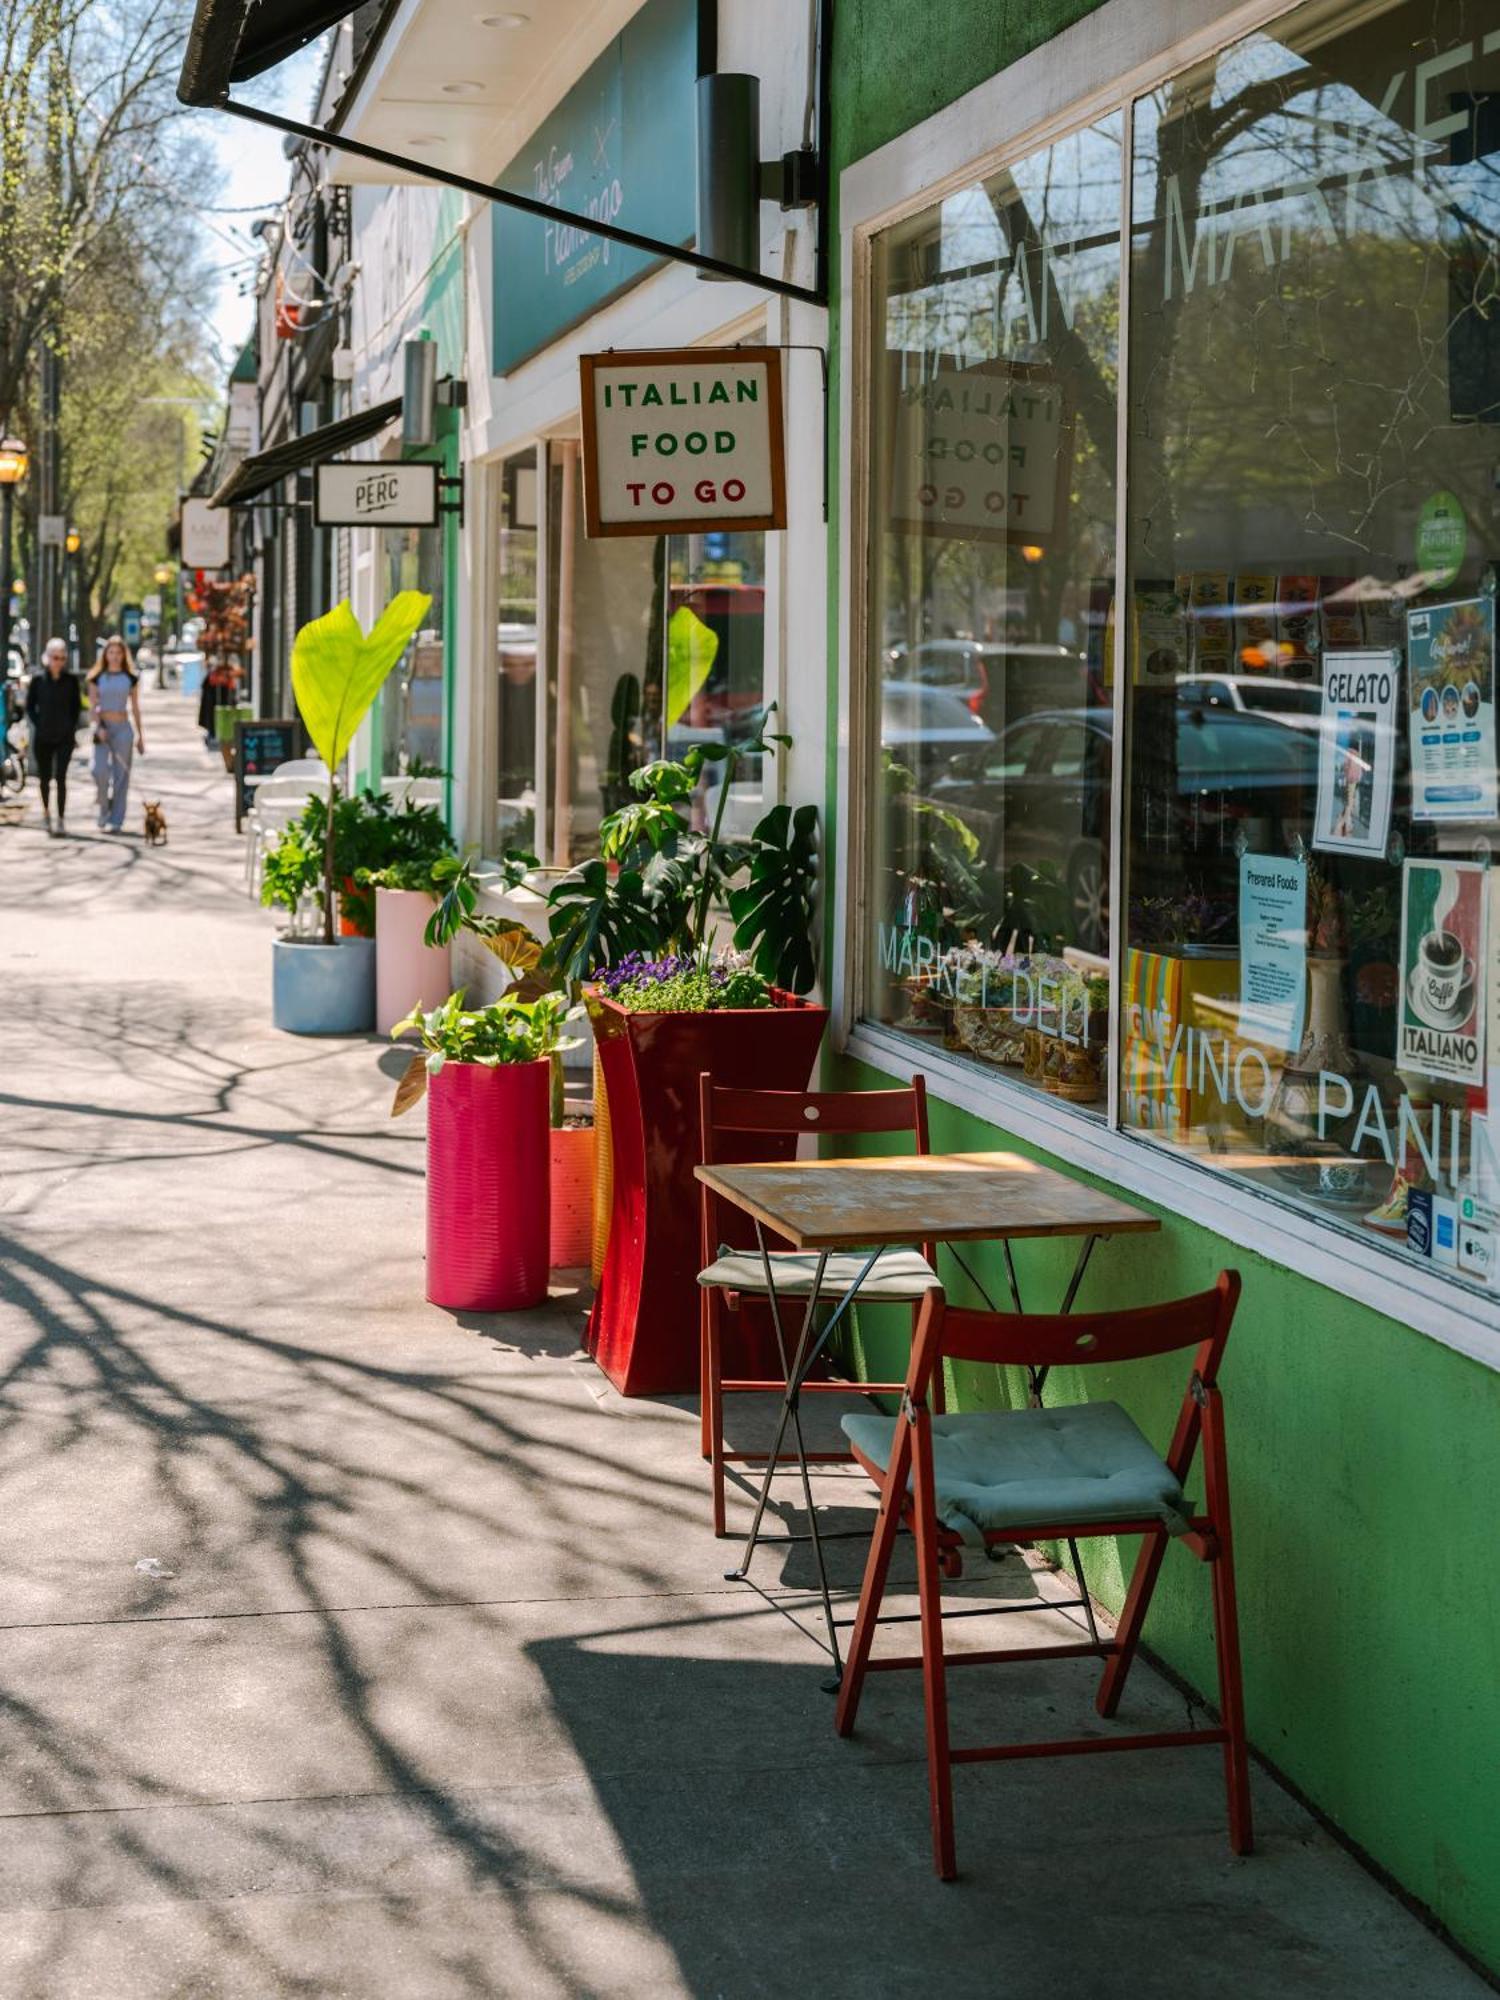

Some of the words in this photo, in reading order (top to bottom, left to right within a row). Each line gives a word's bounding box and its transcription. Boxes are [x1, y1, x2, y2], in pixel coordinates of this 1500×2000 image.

[1164, 31, 1500, 301] MARKE
[604, 379, 758, 408] ITALIAN
[631, 431, 736, 457] FOOD
[356, 478, 398, 508] PERC
[626, 482, 675, 506] TO
[694, 479, 746, 503] GO
[1328, 673, 1390, 704] GELATO
[1277, 874, 1299, 891] Foods
[878, 922, 994, 1009] MARKET
[1012, 968, 1088, 1049] DELI
[1403, 1027, 1477, 1064] ITALIANO
[1155, 1012, 1272, 1118] VINO
